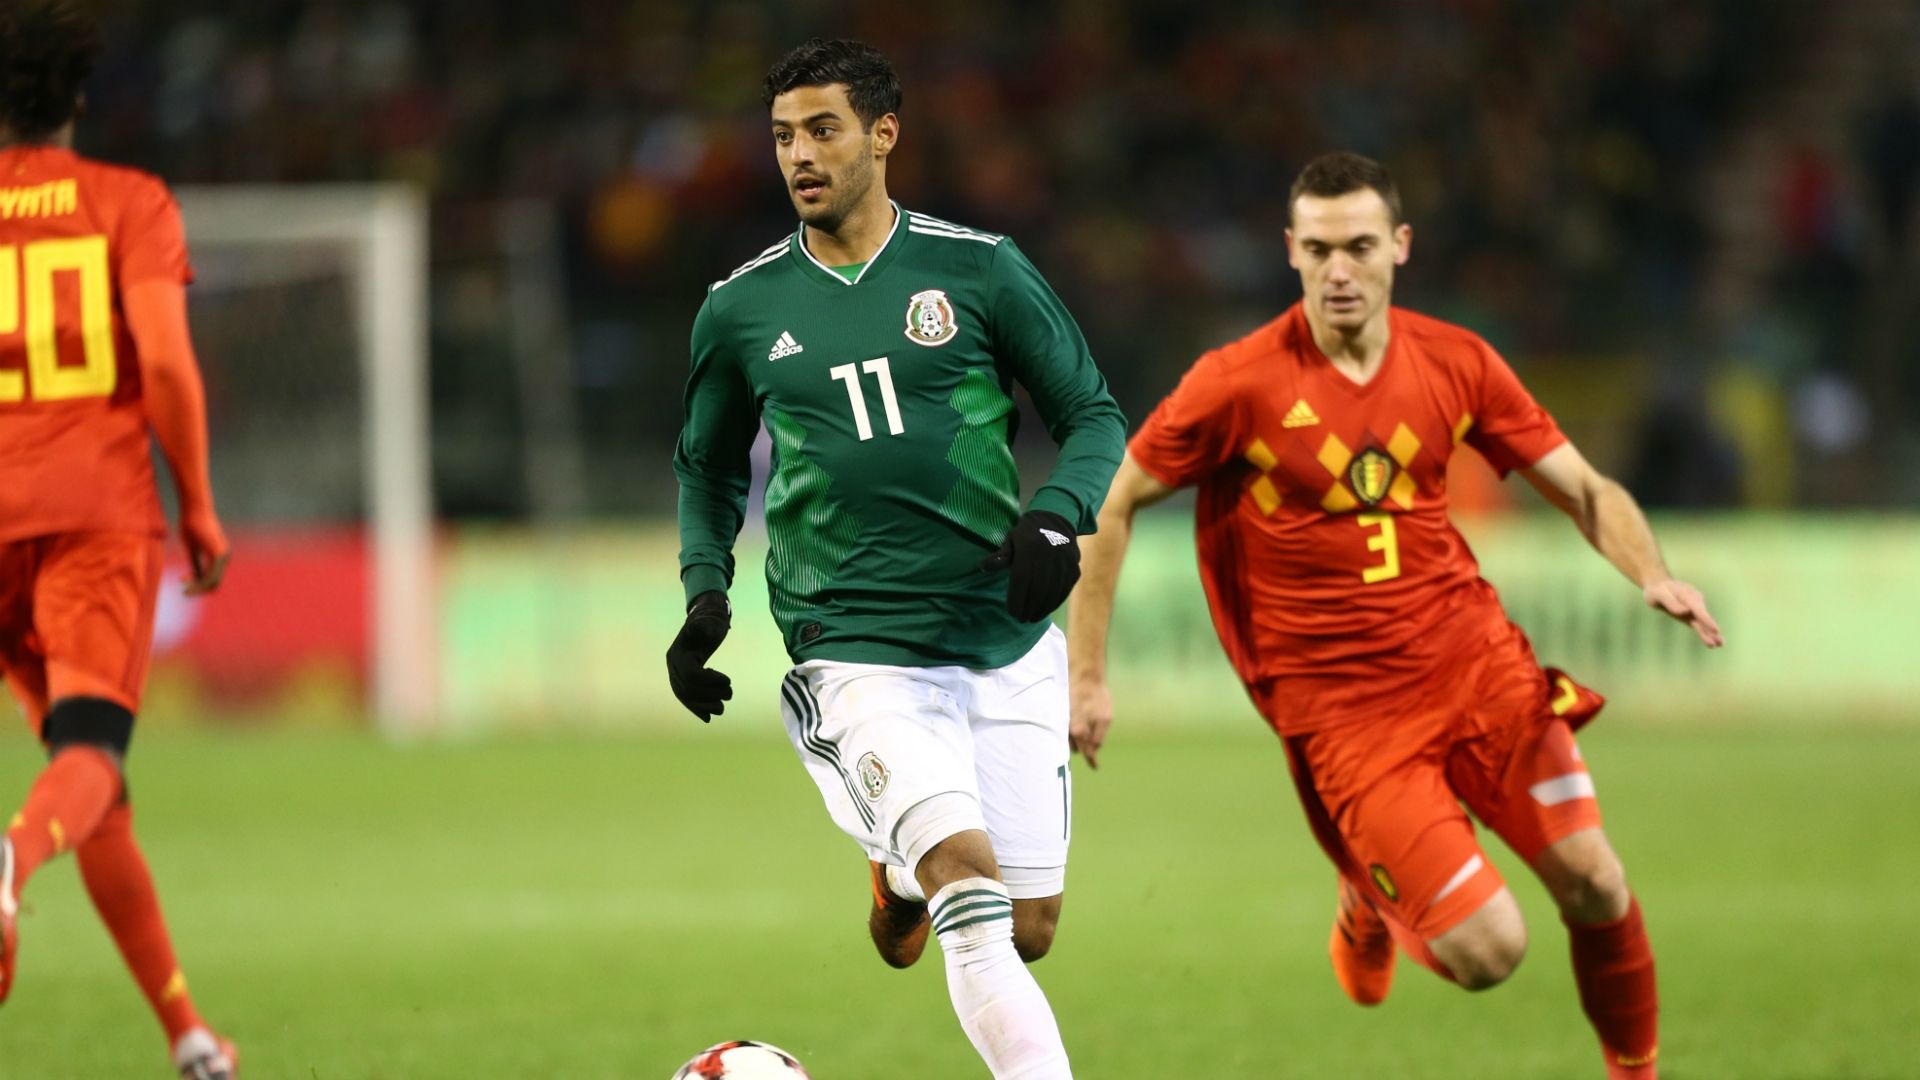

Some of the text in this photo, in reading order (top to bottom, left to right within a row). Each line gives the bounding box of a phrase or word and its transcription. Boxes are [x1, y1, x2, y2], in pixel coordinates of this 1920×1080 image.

[0, 235, 116, 402] 0
[768, 344, 804, 362] adidas
[829, 356, 905, 441] 11
[1356, 513, 1401, 584] 3
